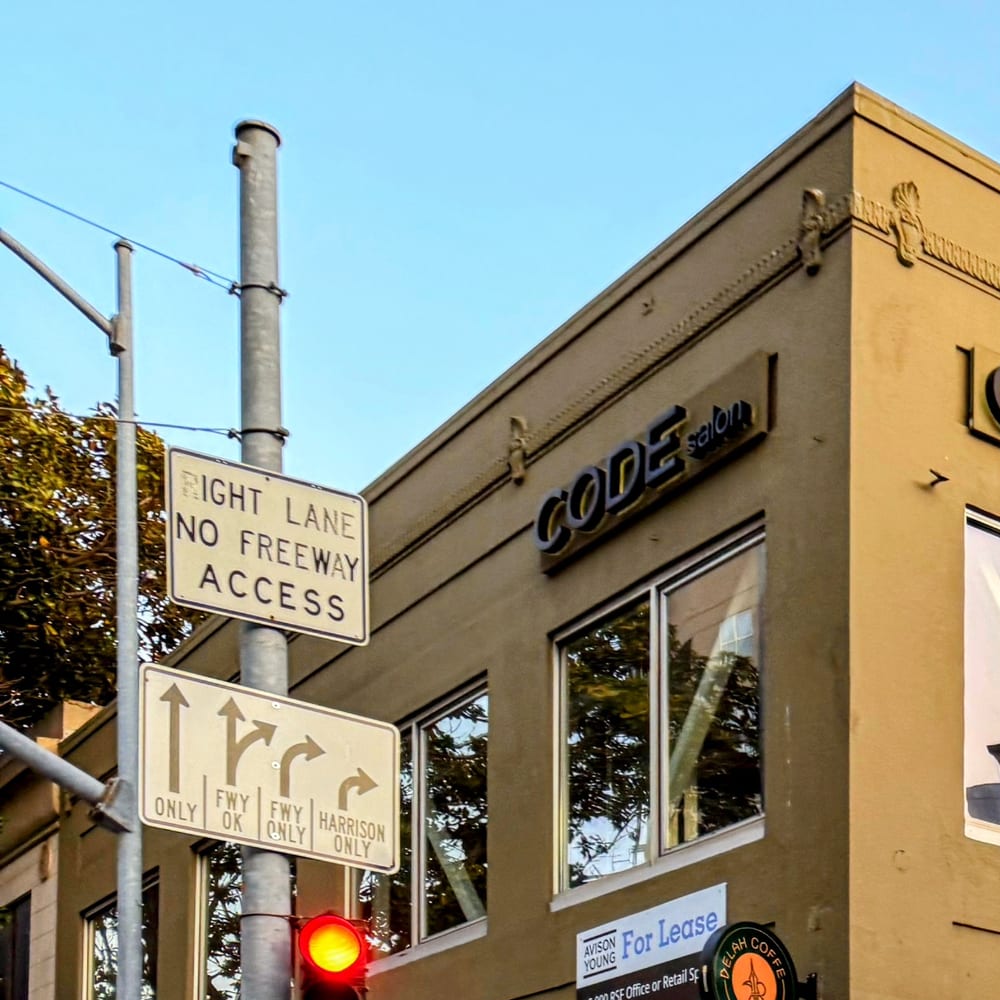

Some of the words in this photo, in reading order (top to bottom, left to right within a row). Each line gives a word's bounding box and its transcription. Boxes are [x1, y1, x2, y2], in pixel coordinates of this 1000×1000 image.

[533, 404, 686, 553] CODE
[686, 400, 752, 459] salon
[286, 496, 355, 540] LANE
[176, 512, 219, 547] NO
[240, 530, 359, 582] FREEWAY
[199, 563, 345, 622] ACCESS
[155, 797, 198, 823] ONLY
[216, 789, 250, 813] FWY
[270, 800, 304, 824] FWY
[223, 811, 243, 833] OK
[266, 820, 307, 845] ONLY
[319, 811, 386, 843] HARRISON
[334, 834, 372, 859] ONLY
[583, 936, 616, 958] AVISON
[621, 929, 653, 959] For
[658, 911, 718, 948] Lease
[583, 952, 616, 972] YOUNG
[720, 937, 748, 979] DELAH
[751, 937, 786, 979] COFFE
[625, 983, 650, 999] Office
[652, 980, 661, 991] or
[662, 971, 688, 989] Retail
